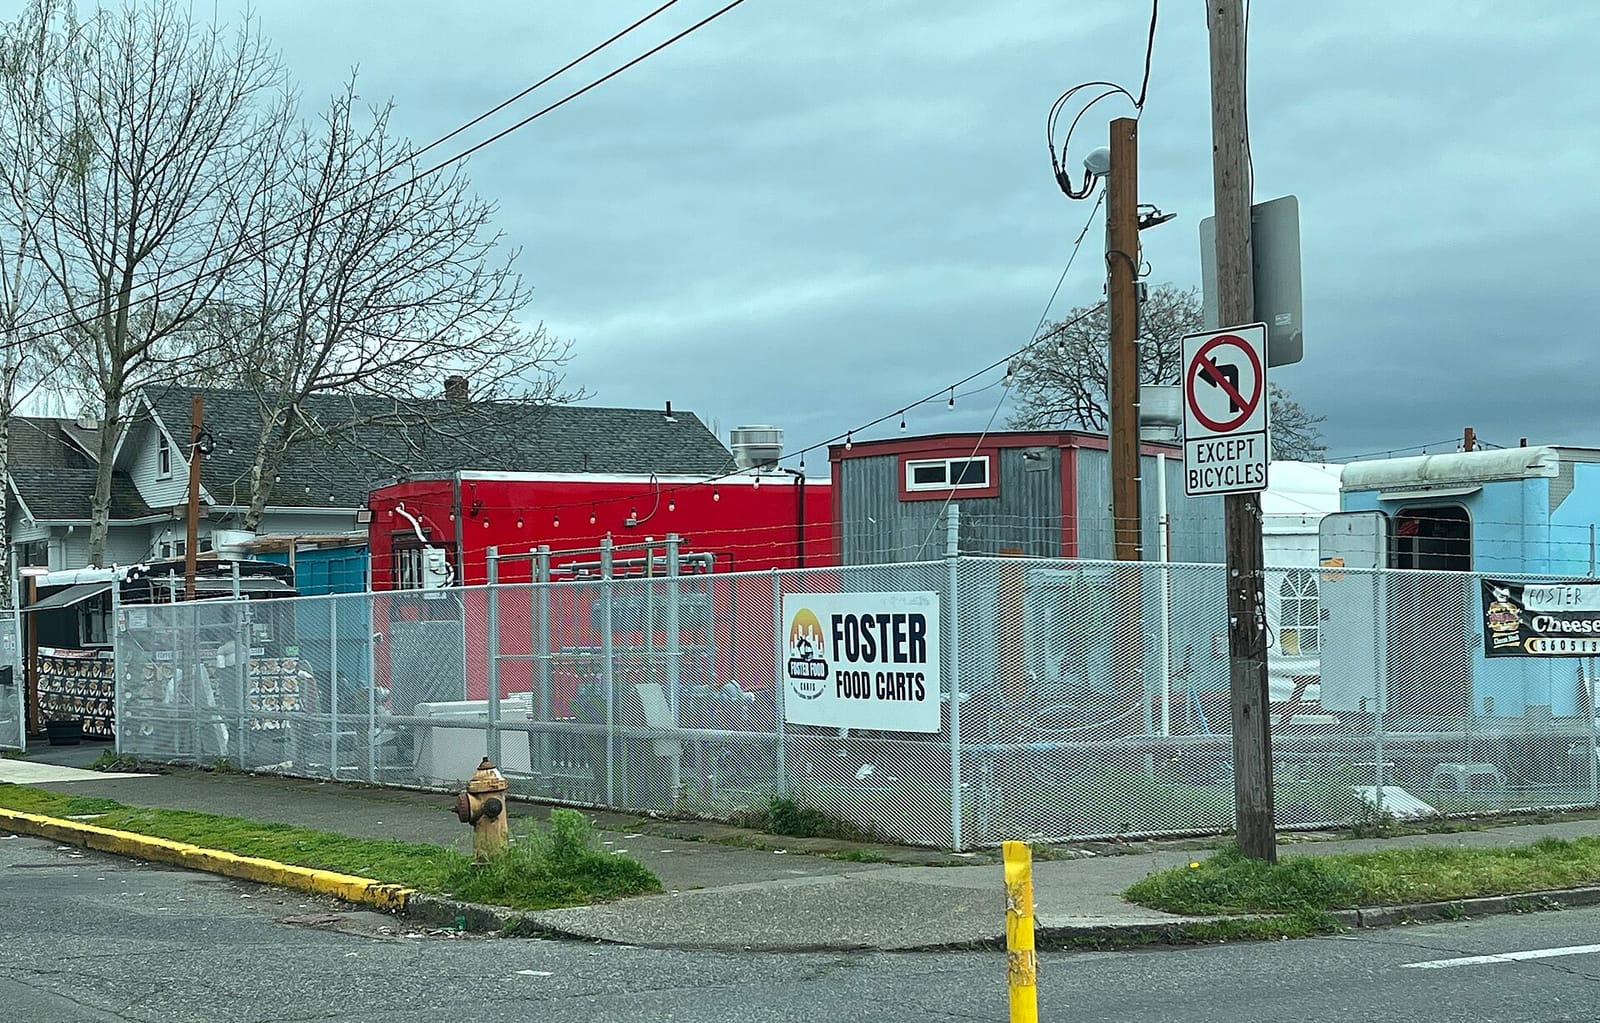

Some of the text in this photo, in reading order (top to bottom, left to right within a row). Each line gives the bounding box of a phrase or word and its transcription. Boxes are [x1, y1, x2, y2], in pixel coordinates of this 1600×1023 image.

[1197, 438, 1255, 463] EXCEPT
[1189, 463, 1264, 489] BICYCLES
[1529, 587, 1582, 606] FOSTER
[1531, 615, 1600, 633] Cheese
[831, 613, 926, 663] FOSTER
[790, 661, 825, 677] FOSTER FOOD
[835, 670, 871, 699] FOOD
[875, 671, 925, 702] CARTS
